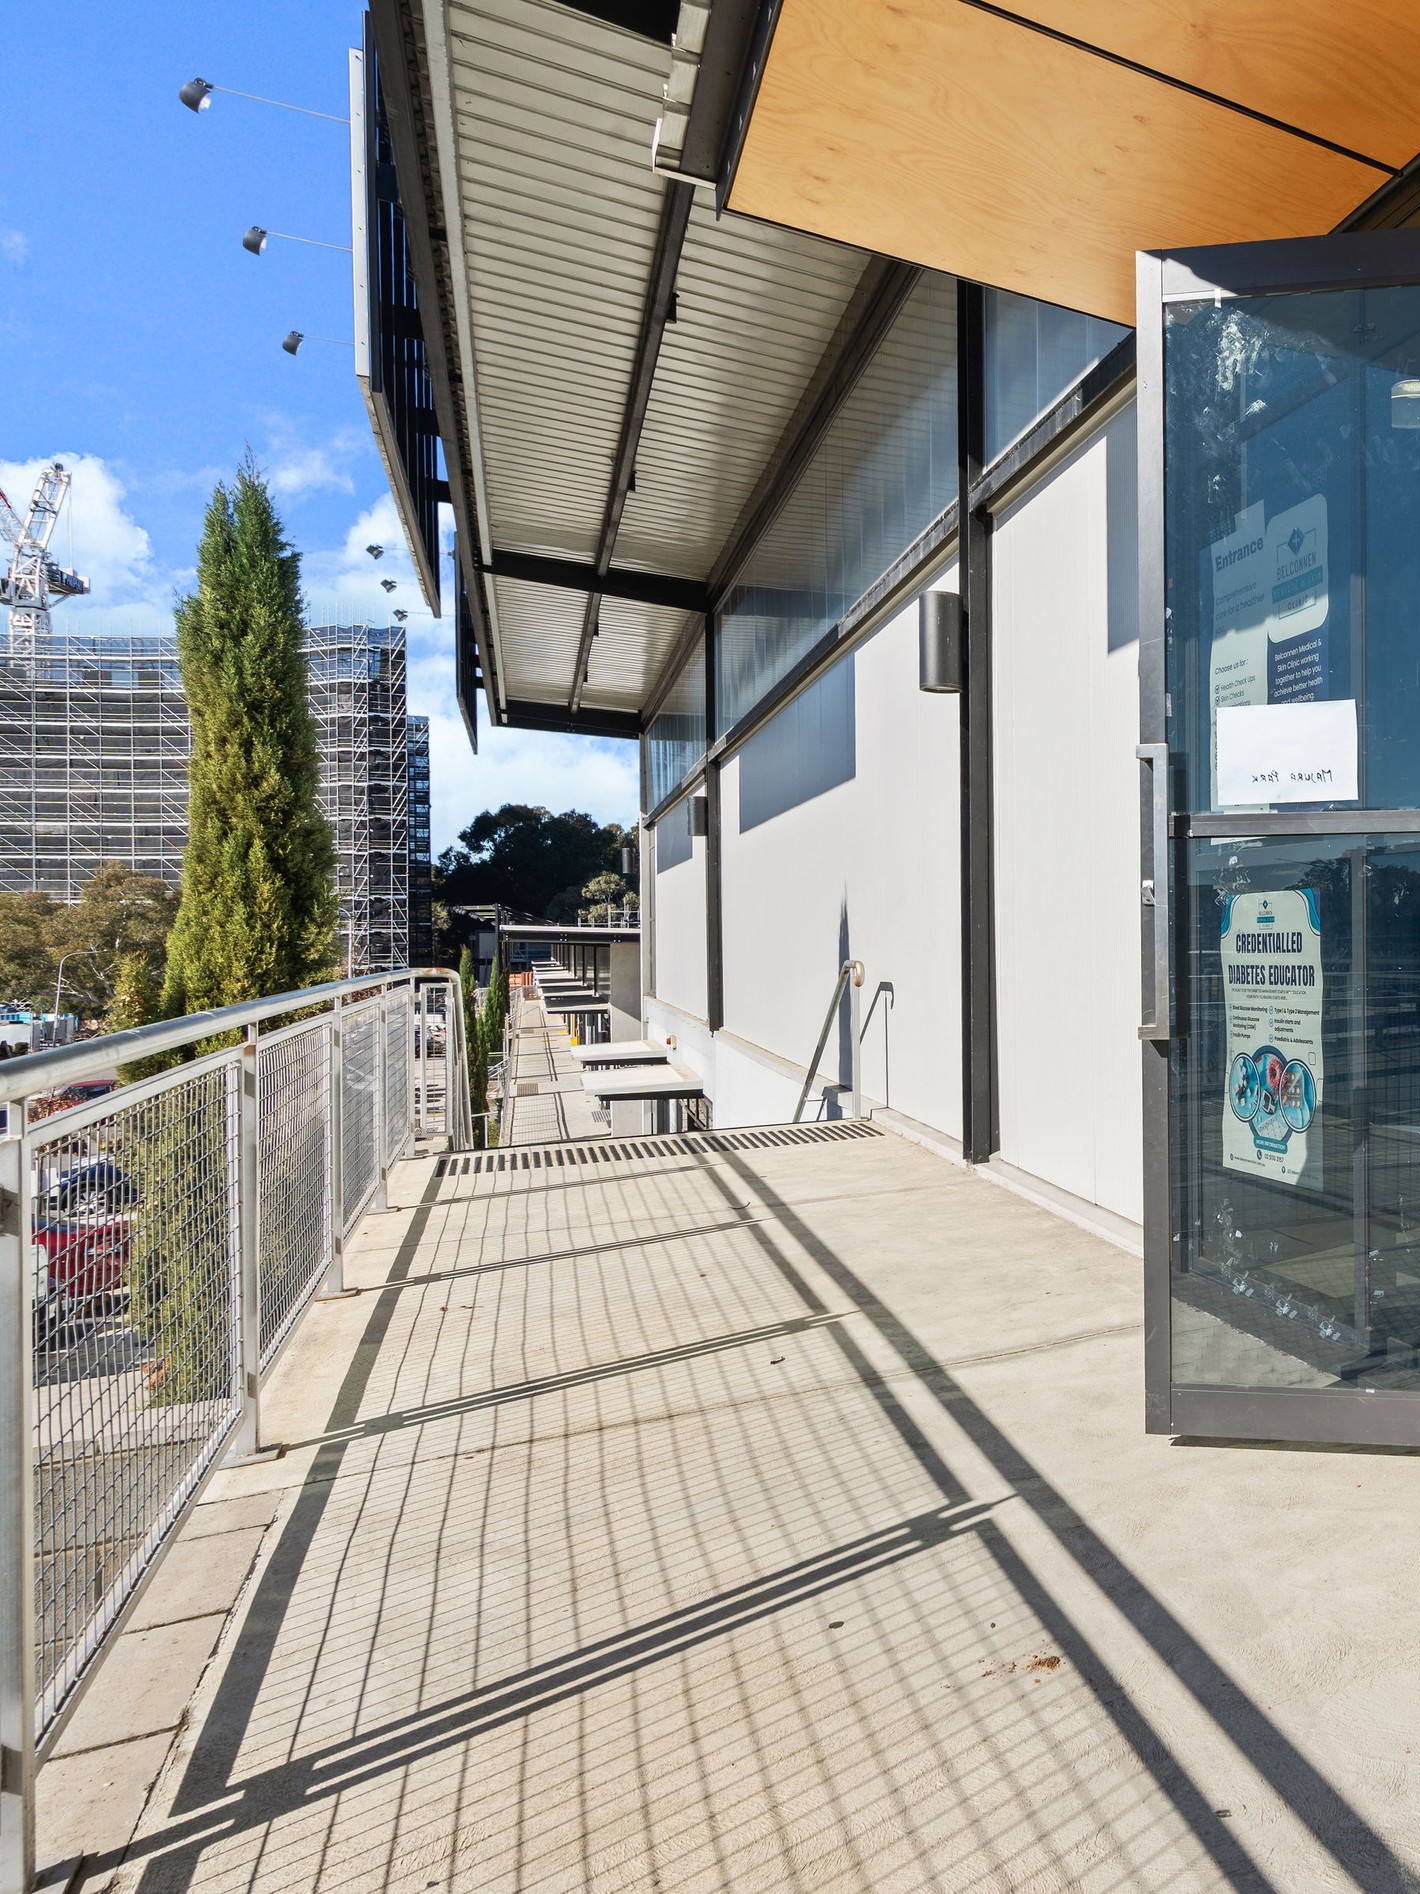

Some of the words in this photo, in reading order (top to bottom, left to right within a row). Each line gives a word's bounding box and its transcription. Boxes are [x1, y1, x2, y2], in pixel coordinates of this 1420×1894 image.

[1215, 537, 1264, 572] Entrance
[1277, 551, 1316, 581] BELCONNEN
[1215, 581, 1257, 606] Comprehensive
[1239, 593, 1265, 610] healthier
[1287, 594, 1308, 611] CLINIC
[1274, 648, 1298, 662] Belconnen
[1298, 639, 1318, 653] Medical
[1317, 638, 1322, 647] &
[1215, 664, 1232, 675] Choose
[1277, 663, 1287, 673] Skin
[1287, 659, 1300, 670] Clinic
[1300, 653, 1319, 665] working
[1235, 677, 1248, 686] Check
[1275, 673, 1295, 686] together
[1300, 668, 1311, 678] help
[1312, 664, 1322, 674] you
[1220, 693, 1230, 703] Skin
[1230, 690, 1244, 700] Checks
[1273, 686, 1292, 698] achieve
[1292, 681, 1307, 692] better
[1307, 676, 1323, 688] health
[1236, 931, 1303, 954] CREDENTIALLED
[1228, 964, 1266, 986] DIABETES
[1268, 965, 1315, 987] EDUCATOR
[1250, 1006, 1268, 1014] Monitoring
[1297, 1009, 1320, 1017] Management
